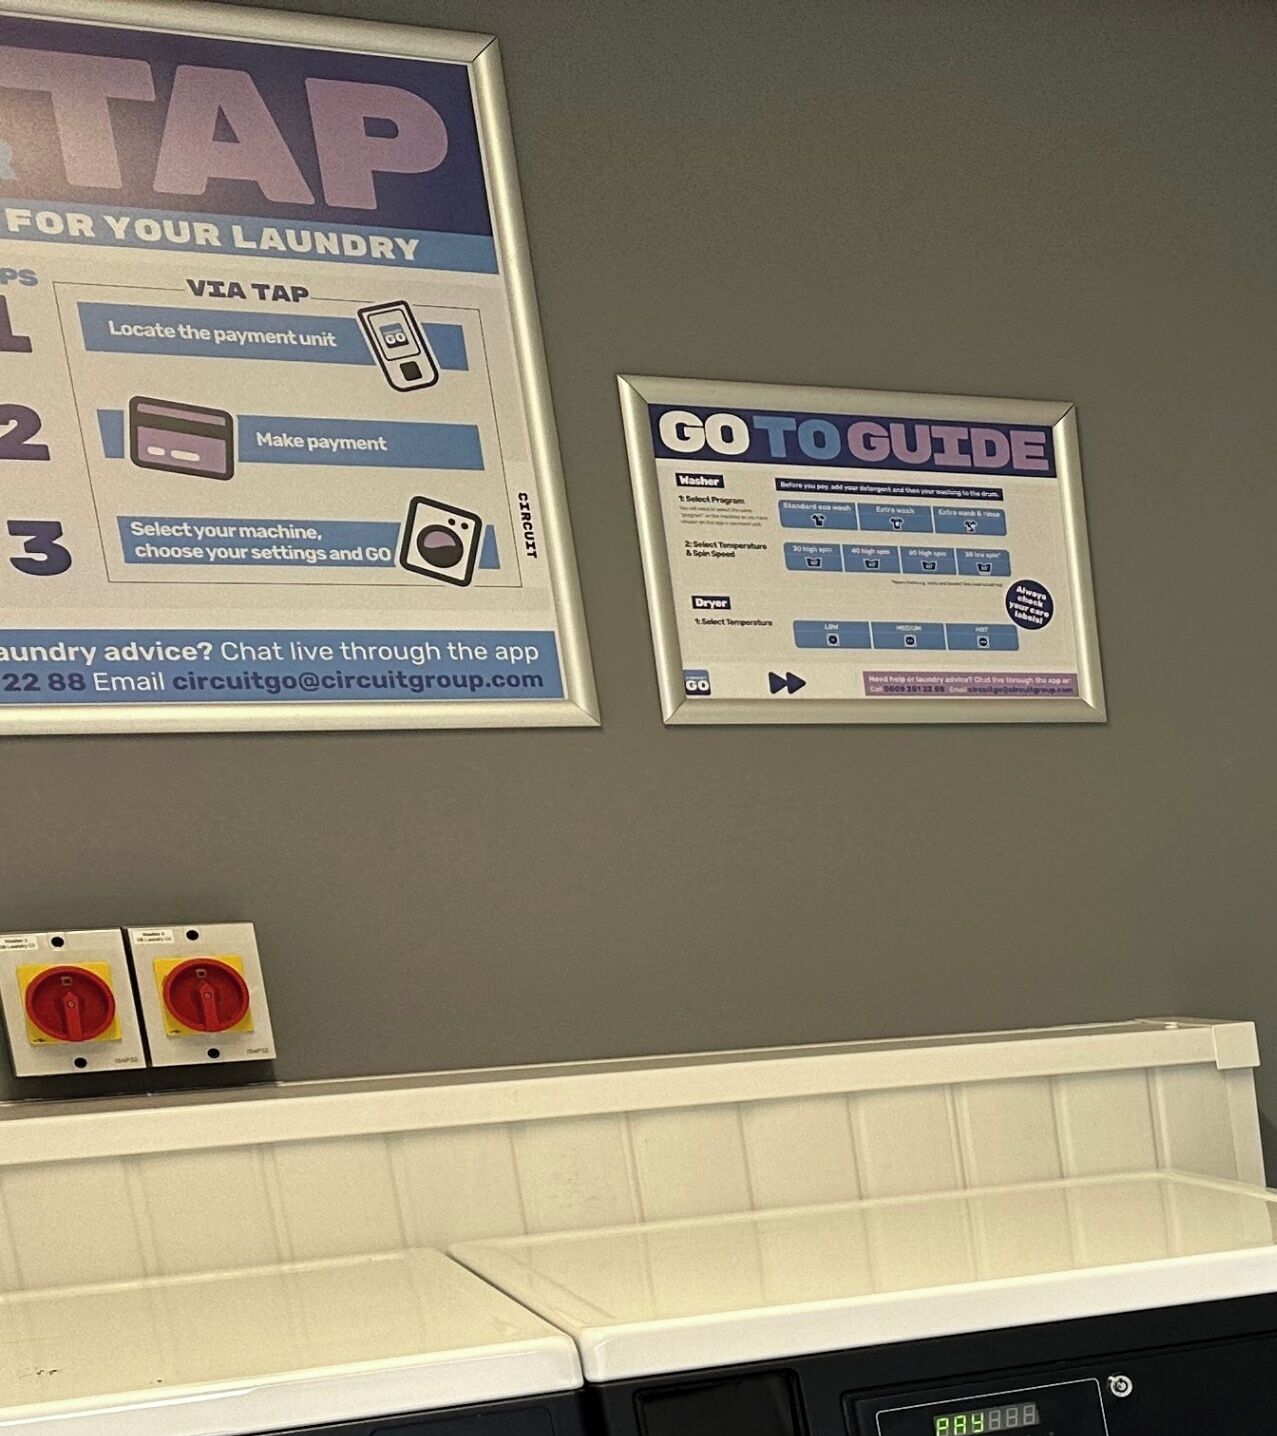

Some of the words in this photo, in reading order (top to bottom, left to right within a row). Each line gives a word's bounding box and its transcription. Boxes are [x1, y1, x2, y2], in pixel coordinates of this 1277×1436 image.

[0, 45, 448, 210] TAP
[5, 207, 95, 237] FOR
[103, 215, 220, 246] YOUR
[232, 225, 417, 259] LAUNDRY
[186, 279, 246, 299] VIA
[251, 283, 309, 302] TAP
[108, 320, 175, 338] Locate
[177, 324, 211, 340] the
[213, 329, 297, 345] payment
[299, 331, 337, 347] unit
[385, 332, 407, 345] GO
[0, 404, 50, 460] 2
[256, 432, 304, 447] Make
[307, 436, 387, 452] payment
[658, 410, 750, 455] GO
[752, 415, 841, 459] TO
[847, 421, 1051, 471] GUIDE
[678, 475, 720, 487] Washer
[685, 495, 710, 503] Select
[711, 496, 745, 505] Program
[130, 521, 192, 536] Select
[193, 525, 237, 540] your
[239, 525, 321, 540] machine,
[518, 492, 537, 559] CIRCUIT
[7, 520, 72, 576] 3
[135, 543, 203, 558] choose
[205, 547, 248, 561] your
[251, 545, 327, 563] settings
[329, 546, 363, 560] and
[365, 546, 391, 561] GO
[692, 550, 710, 558] Spin
[693, 540, 717, 548] Select
[718, 541, 767, 550] Temperature
[695, 598, 728, 610] Dryer
[726, 618, 773, 626] Temperature
[104, 641, 212, 661] advice?
[220, 641, 283, 660] Chat
[290, 641, 333, 660] live
[339, 642, 440, 665] through
[446, 642, 487, 660] the
[495, 646, 538, 664] app
[2, 672, 41, 692] 22
[48, 672, 86, 692] 88
[93, 672, 165, 691] Email
[172, 671, 544, 693] circuitgo@circuitgroup.com
[685, 678, 709, 692] GO
